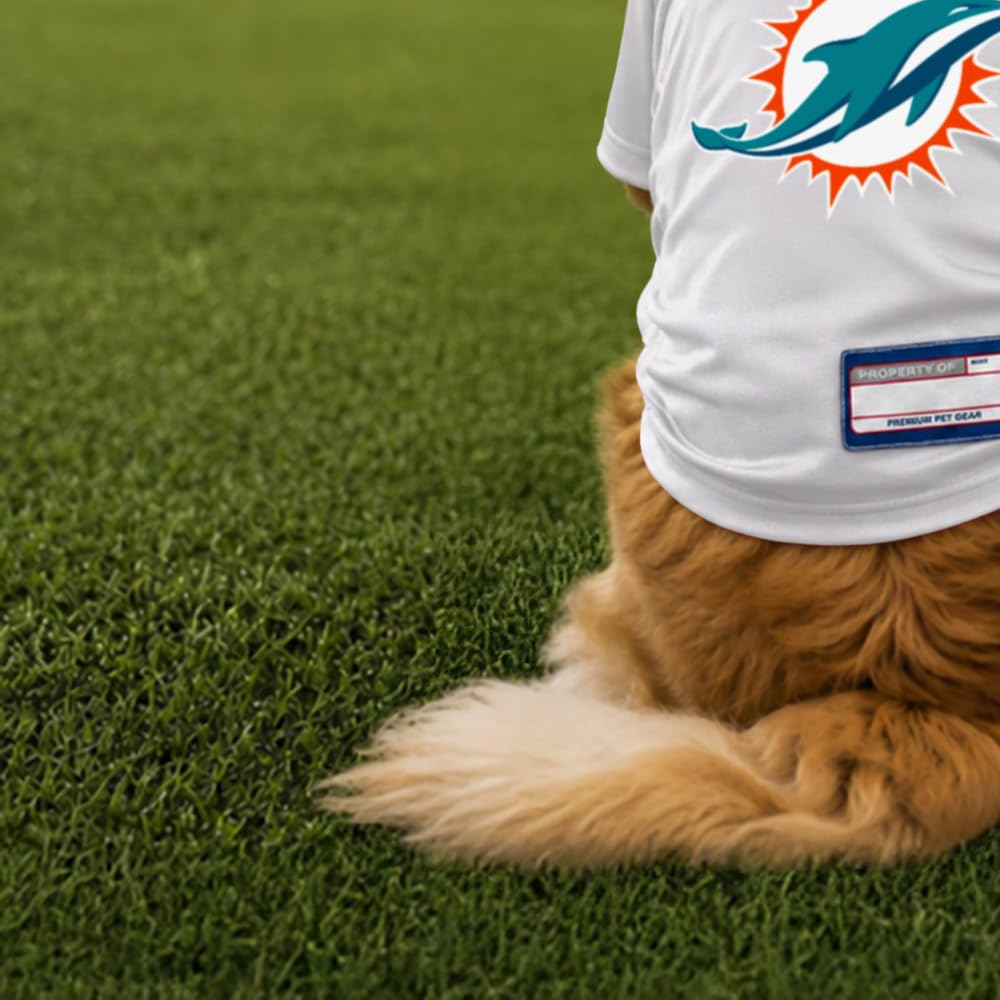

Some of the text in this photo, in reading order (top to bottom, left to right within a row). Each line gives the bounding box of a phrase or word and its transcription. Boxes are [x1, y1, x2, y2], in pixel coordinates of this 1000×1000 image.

[858, 364, 934, 380] PROPERTY
[936, 361, 956, 373] OF
[934, 413, 953, 423] PET
[954, 410, 983, 421] GEAR
